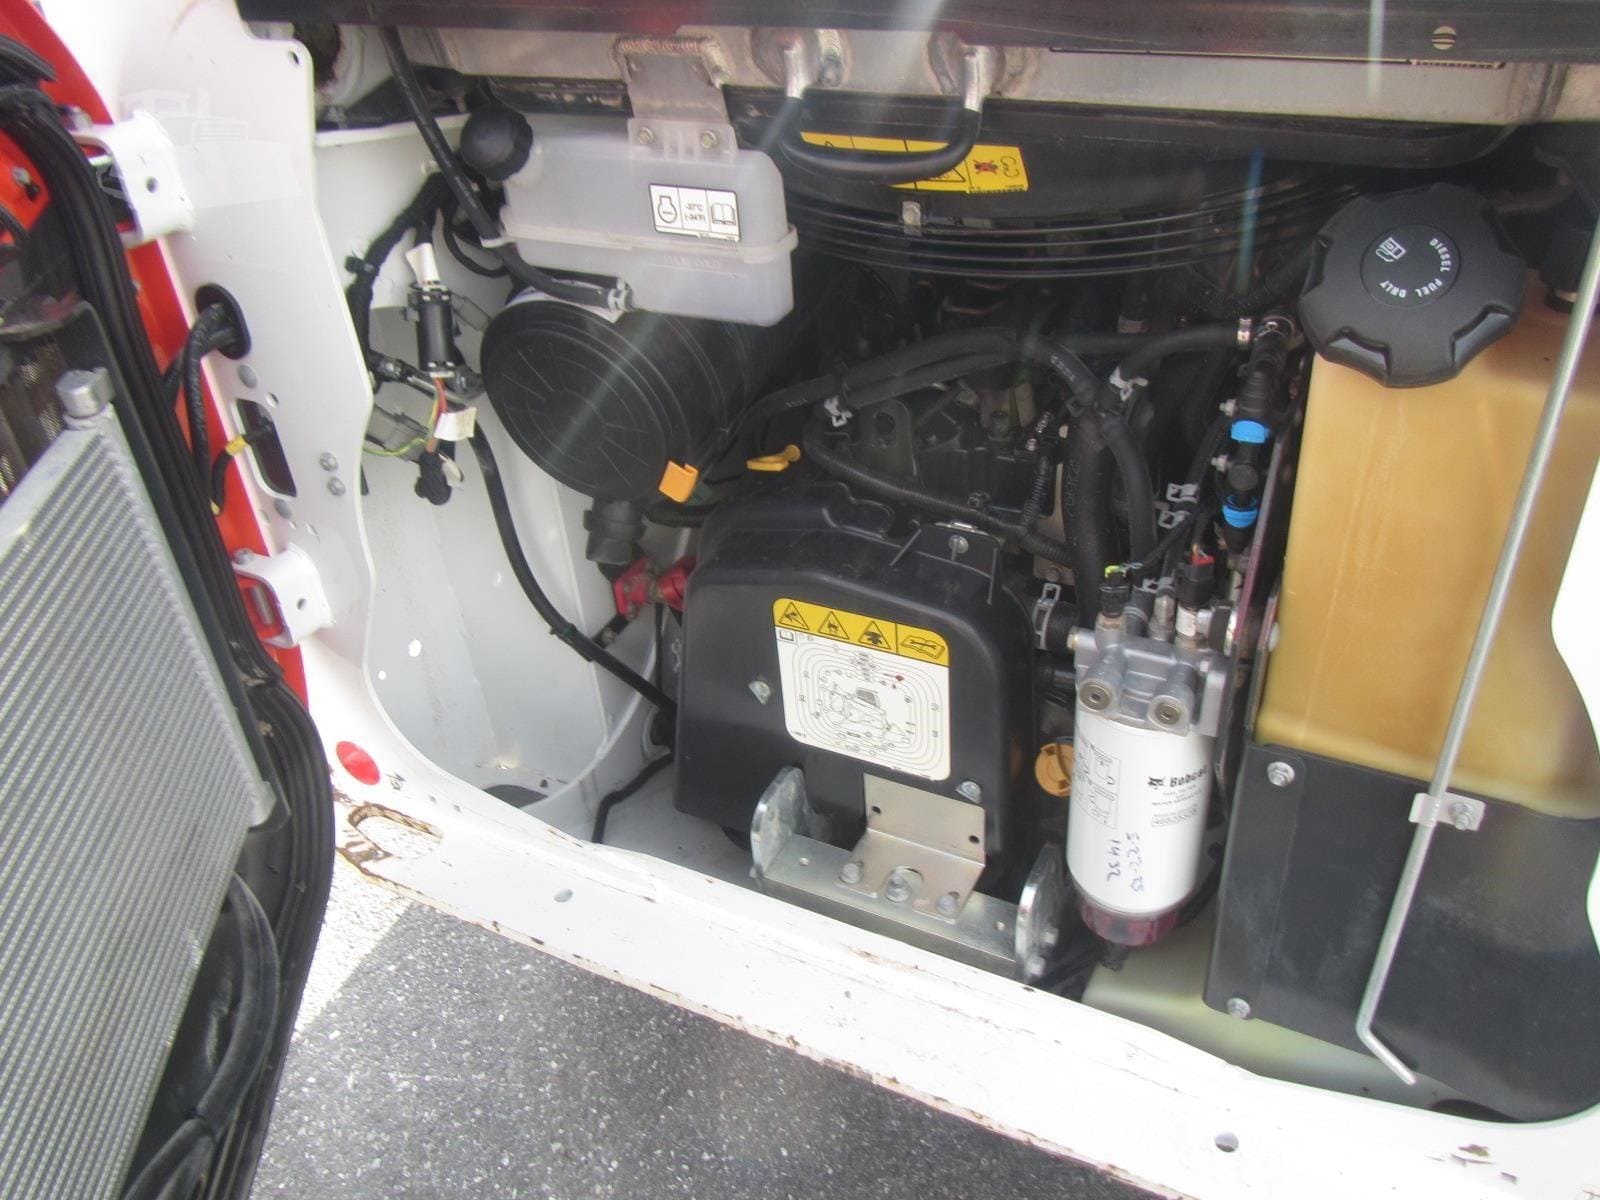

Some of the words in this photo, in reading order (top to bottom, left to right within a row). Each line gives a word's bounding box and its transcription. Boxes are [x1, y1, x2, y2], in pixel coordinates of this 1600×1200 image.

[1429, 238, 1451, 272] DIESEL
[1379, 280, 1407, 298] ONLY
[1415, 278, 1442, 297] FUEL
[1106, 839, 1121, 882] 1432
